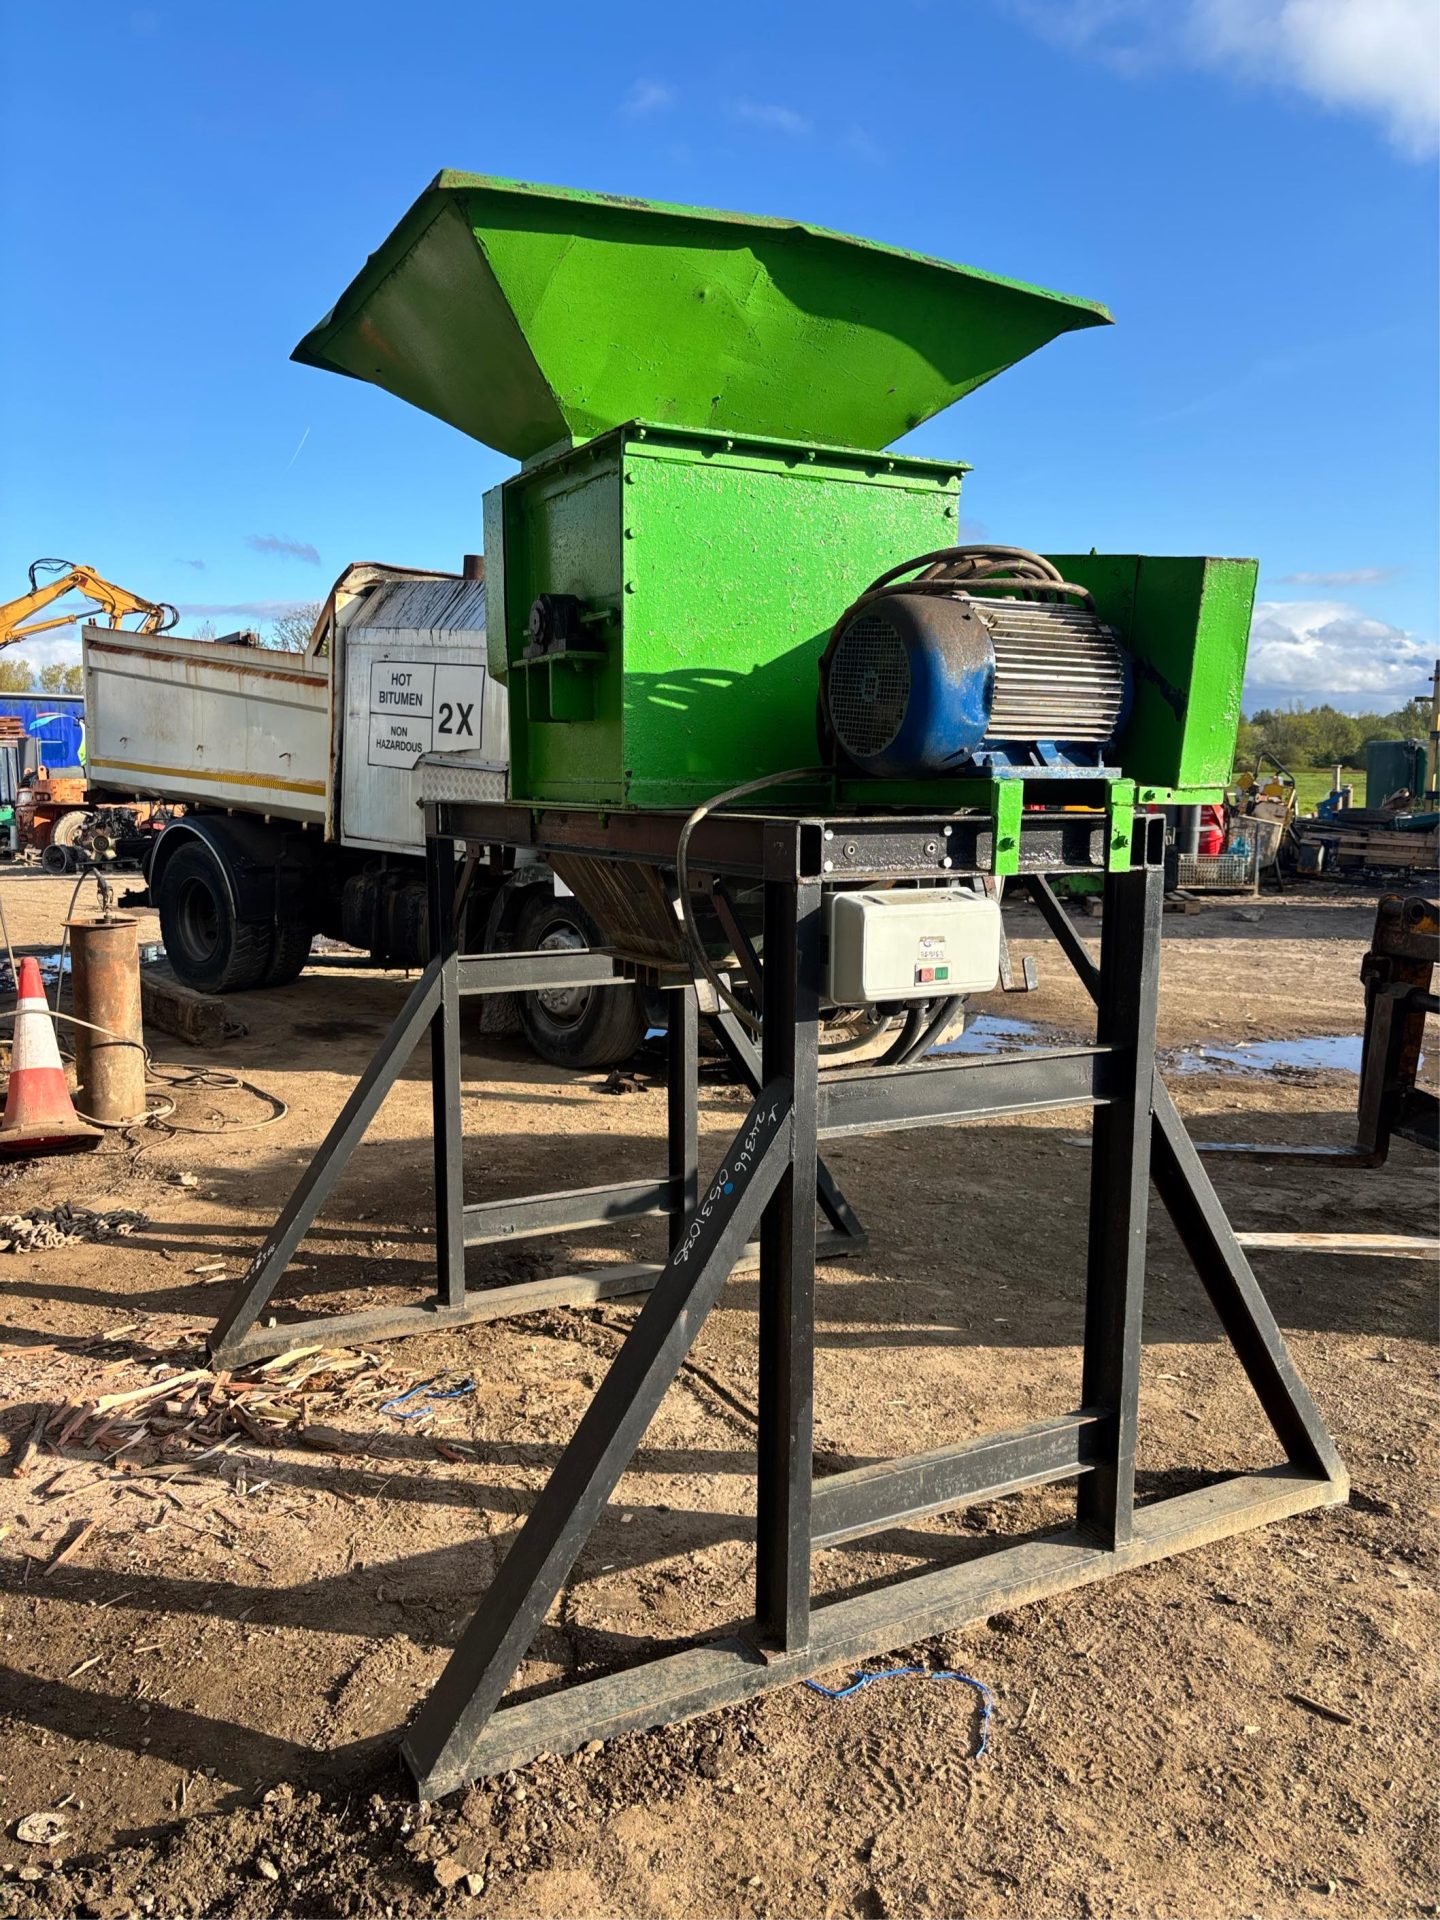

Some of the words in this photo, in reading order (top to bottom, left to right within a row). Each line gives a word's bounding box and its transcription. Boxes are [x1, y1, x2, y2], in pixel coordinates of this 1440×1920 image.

[391, 673, 412, 686] HOT
[379, 691, 422, 706] BITUMEN
[438, 702, 474, 736] 2X
[391, 726, 408, 737] NON
[376, 739, 422, 753] HAZARDOUS
